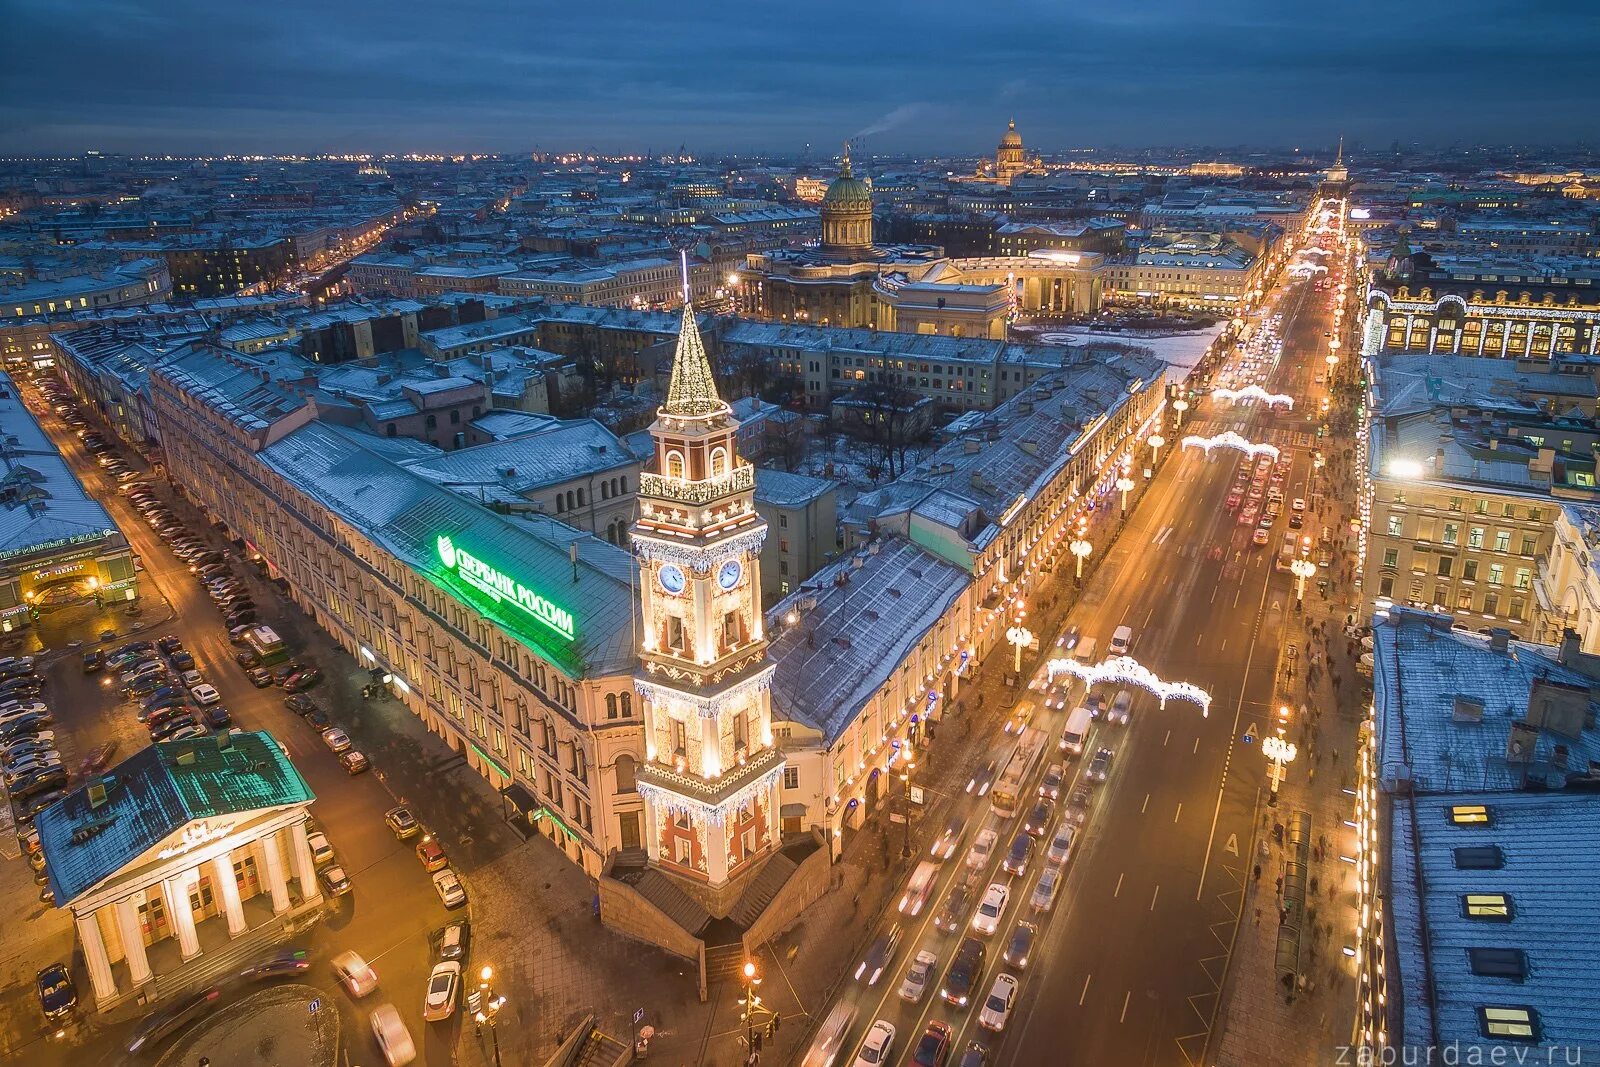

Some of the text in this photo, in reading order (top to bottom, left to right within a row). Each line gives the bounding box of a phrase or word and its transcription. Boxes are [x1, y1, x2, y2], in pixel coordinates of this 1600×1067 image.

[33, 564, 84, 581] АРТ ЦЕНТР
[456, 548, 517, 600] СБЕРБАНК
[517, 583, 574, 635] РОССИИ
